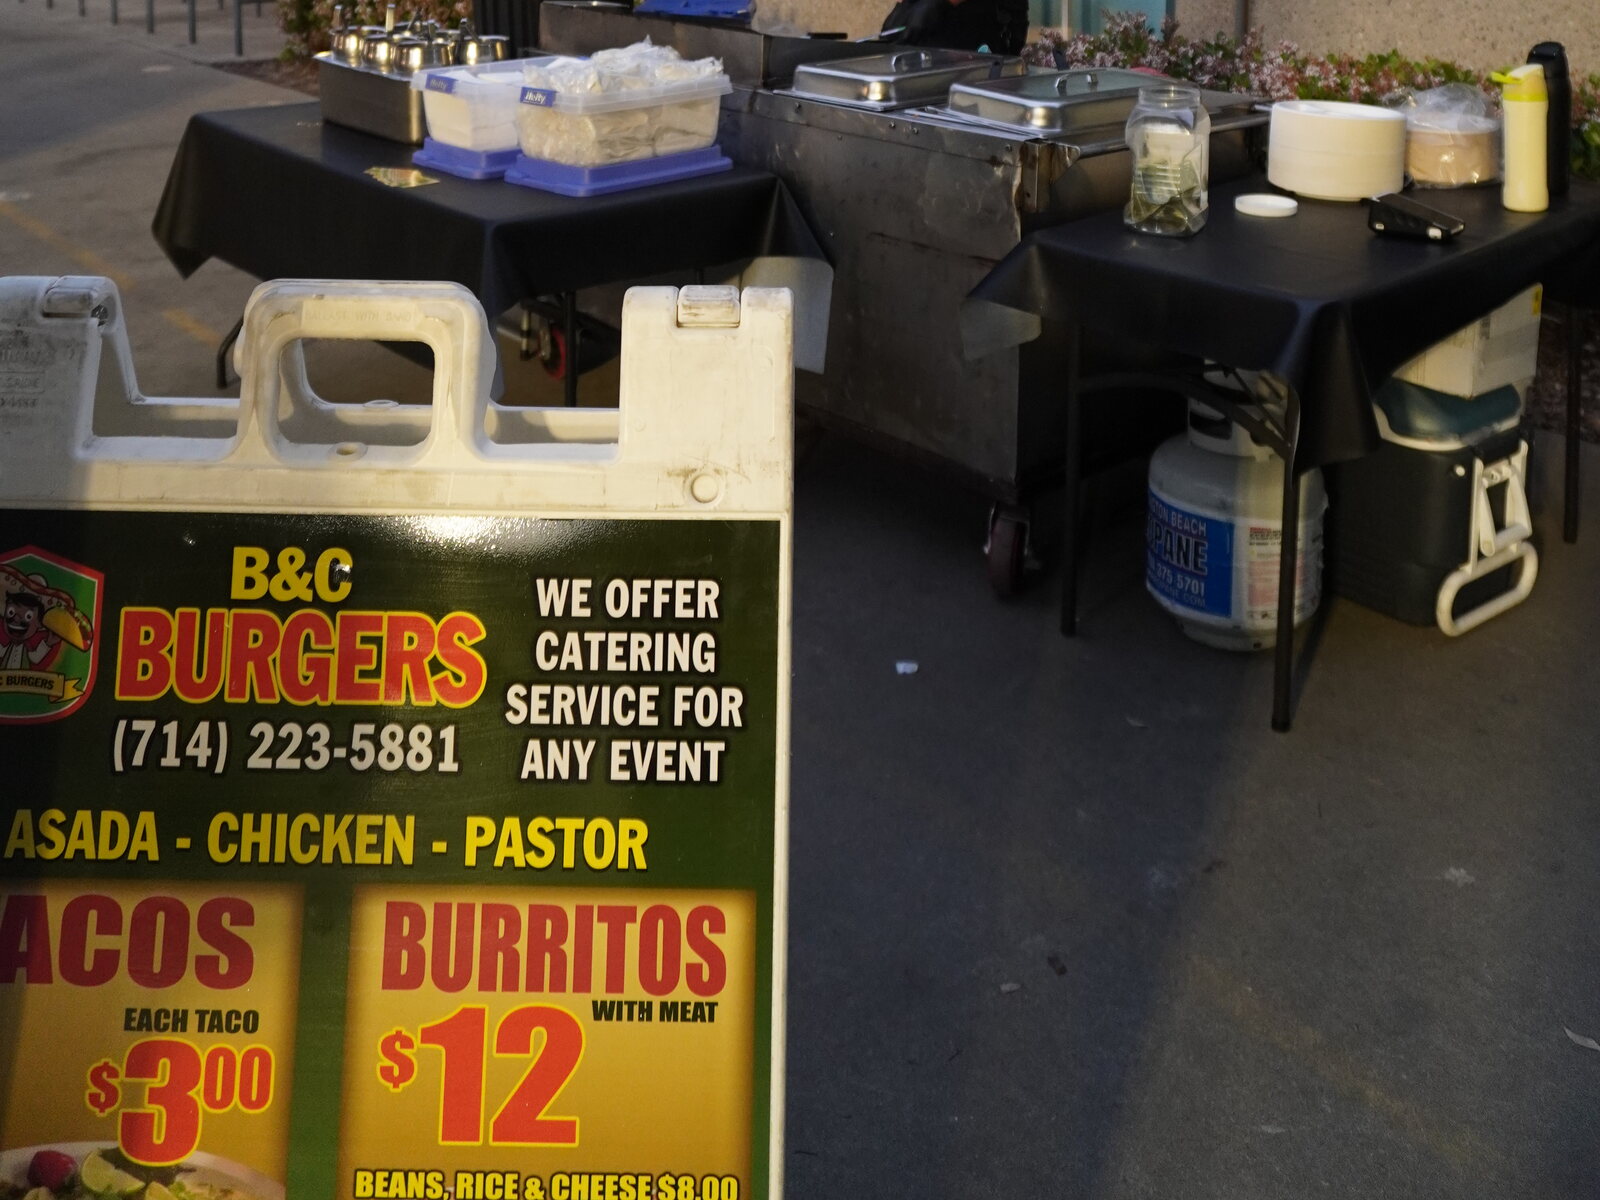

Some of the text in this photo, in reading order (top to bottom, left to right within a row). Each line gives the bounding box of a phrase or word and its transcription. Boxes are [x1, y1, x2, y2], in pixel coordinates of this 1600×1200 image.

[524, 90, 546, 105] Hefty
[1170, 511, 1207, 537] BEACH
[230, 546, 353, 603] B&C
[1176, 574, 1206, 597] 5701
[536, 578, 720, 619] WE OFFER
[115, 606, 487, 709] BURGERS
[535, 630, 716, 673] CATERING
[6, 675, 55, 690] BURGERS
[505, 684, 744, 727] SERVICE FOR
[113, 719, 459, 774] (714) 223-5881
[521, 739, 726, 782] ANY EVENT
[5, 808, 160, 861] ASADA
[207, 811, 416, 866] CHICKEN
[464, 815, 650, 870] PASTOR
[0, 894, 255, 990] ACOS
[381, 900, 728, 997] BURRITOS
[123, 1007, 260, 1034] EACH TACO
[592, 1000, 719, 1023] WITH MEAT
[376, 1003, 586, 1148] $12
[355, 1171, 739, 1200] BEANS, RICE & CHEESE $8.00
